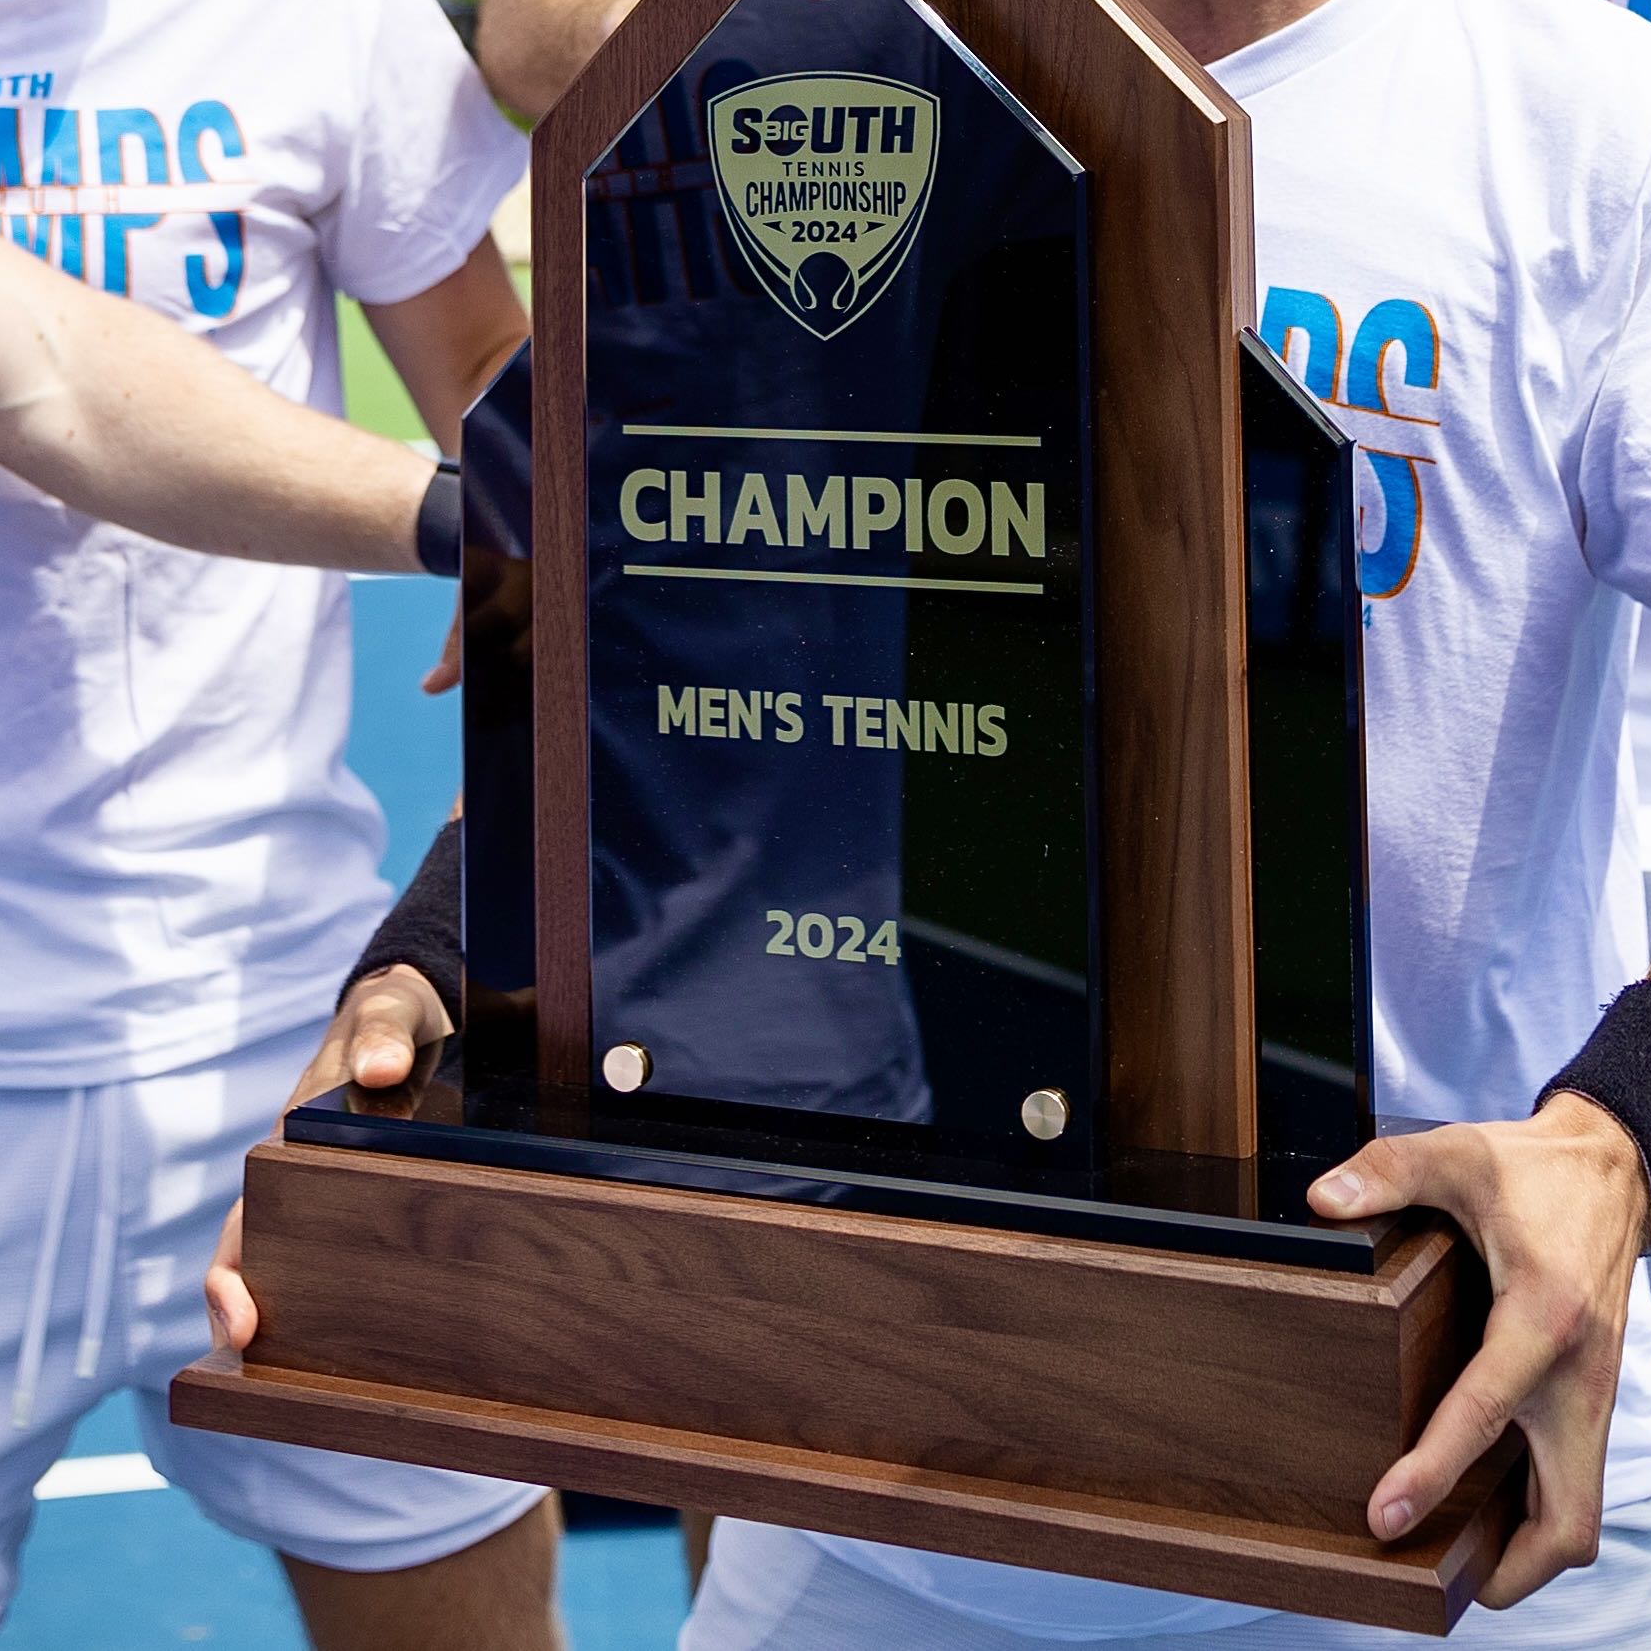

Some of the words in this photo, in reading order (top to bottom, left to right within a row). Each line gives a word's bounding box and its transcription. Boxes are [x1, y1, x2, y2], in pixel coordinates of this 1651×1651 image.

[730, 104, 917, 157] SOUTH
[763, 120, 809, 141] BIG
[781, 161, 865, 177] TENNIS
[745, 181, 907, 218] CHAMPIONSHIP
[790, 220, 858, 243] 2024
[619, 468, 1046, 558] CHAMPION
[656, 684, 805, 745] MEN'S
[821, 694, 1009, 757] TENNIS
[765, 909, 902, 966] 2024
